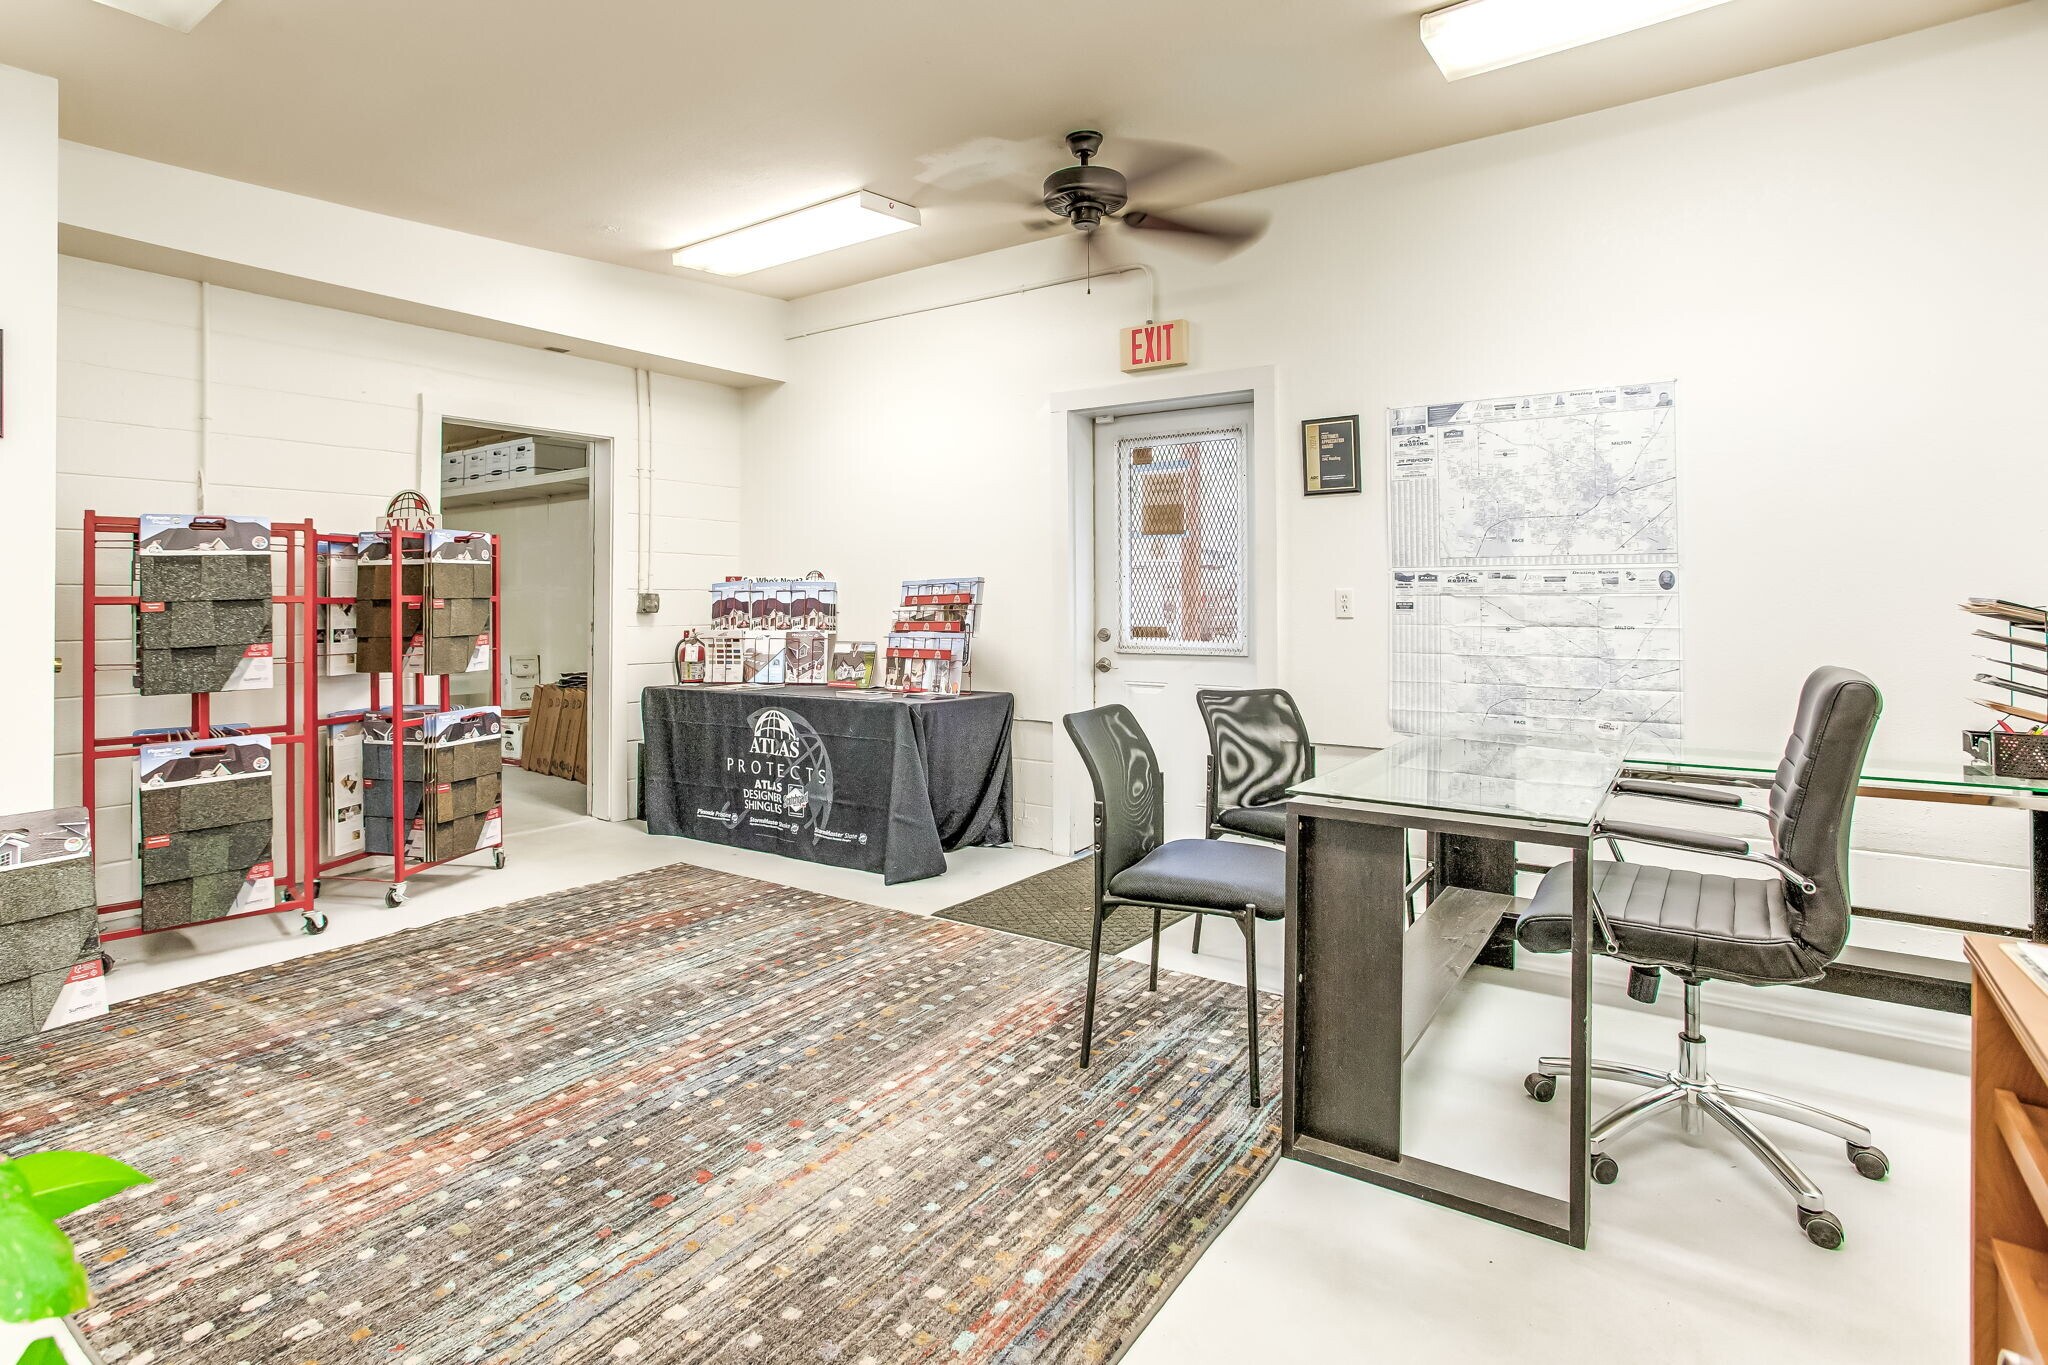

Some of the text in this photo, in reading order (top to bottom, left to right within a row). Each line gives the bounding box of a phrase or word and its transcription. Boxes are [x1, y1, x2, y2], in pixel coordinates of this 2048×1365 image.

[1131, 324, 1174, 365] EXIT
[384, 516, 435, 530] ATLAS
[750, 737, 800, 758] ATLAS
[727, 758, 826, 784] PROTECTS
[754, 779, 783, 792] ATLAS
[743, 789, 782, 803] DESIGNER
[744, 799, 782, 814] SHINGLES
[750, 816, 778, 826] StormMaster
[814, 828, 844, 838] StormMaster
